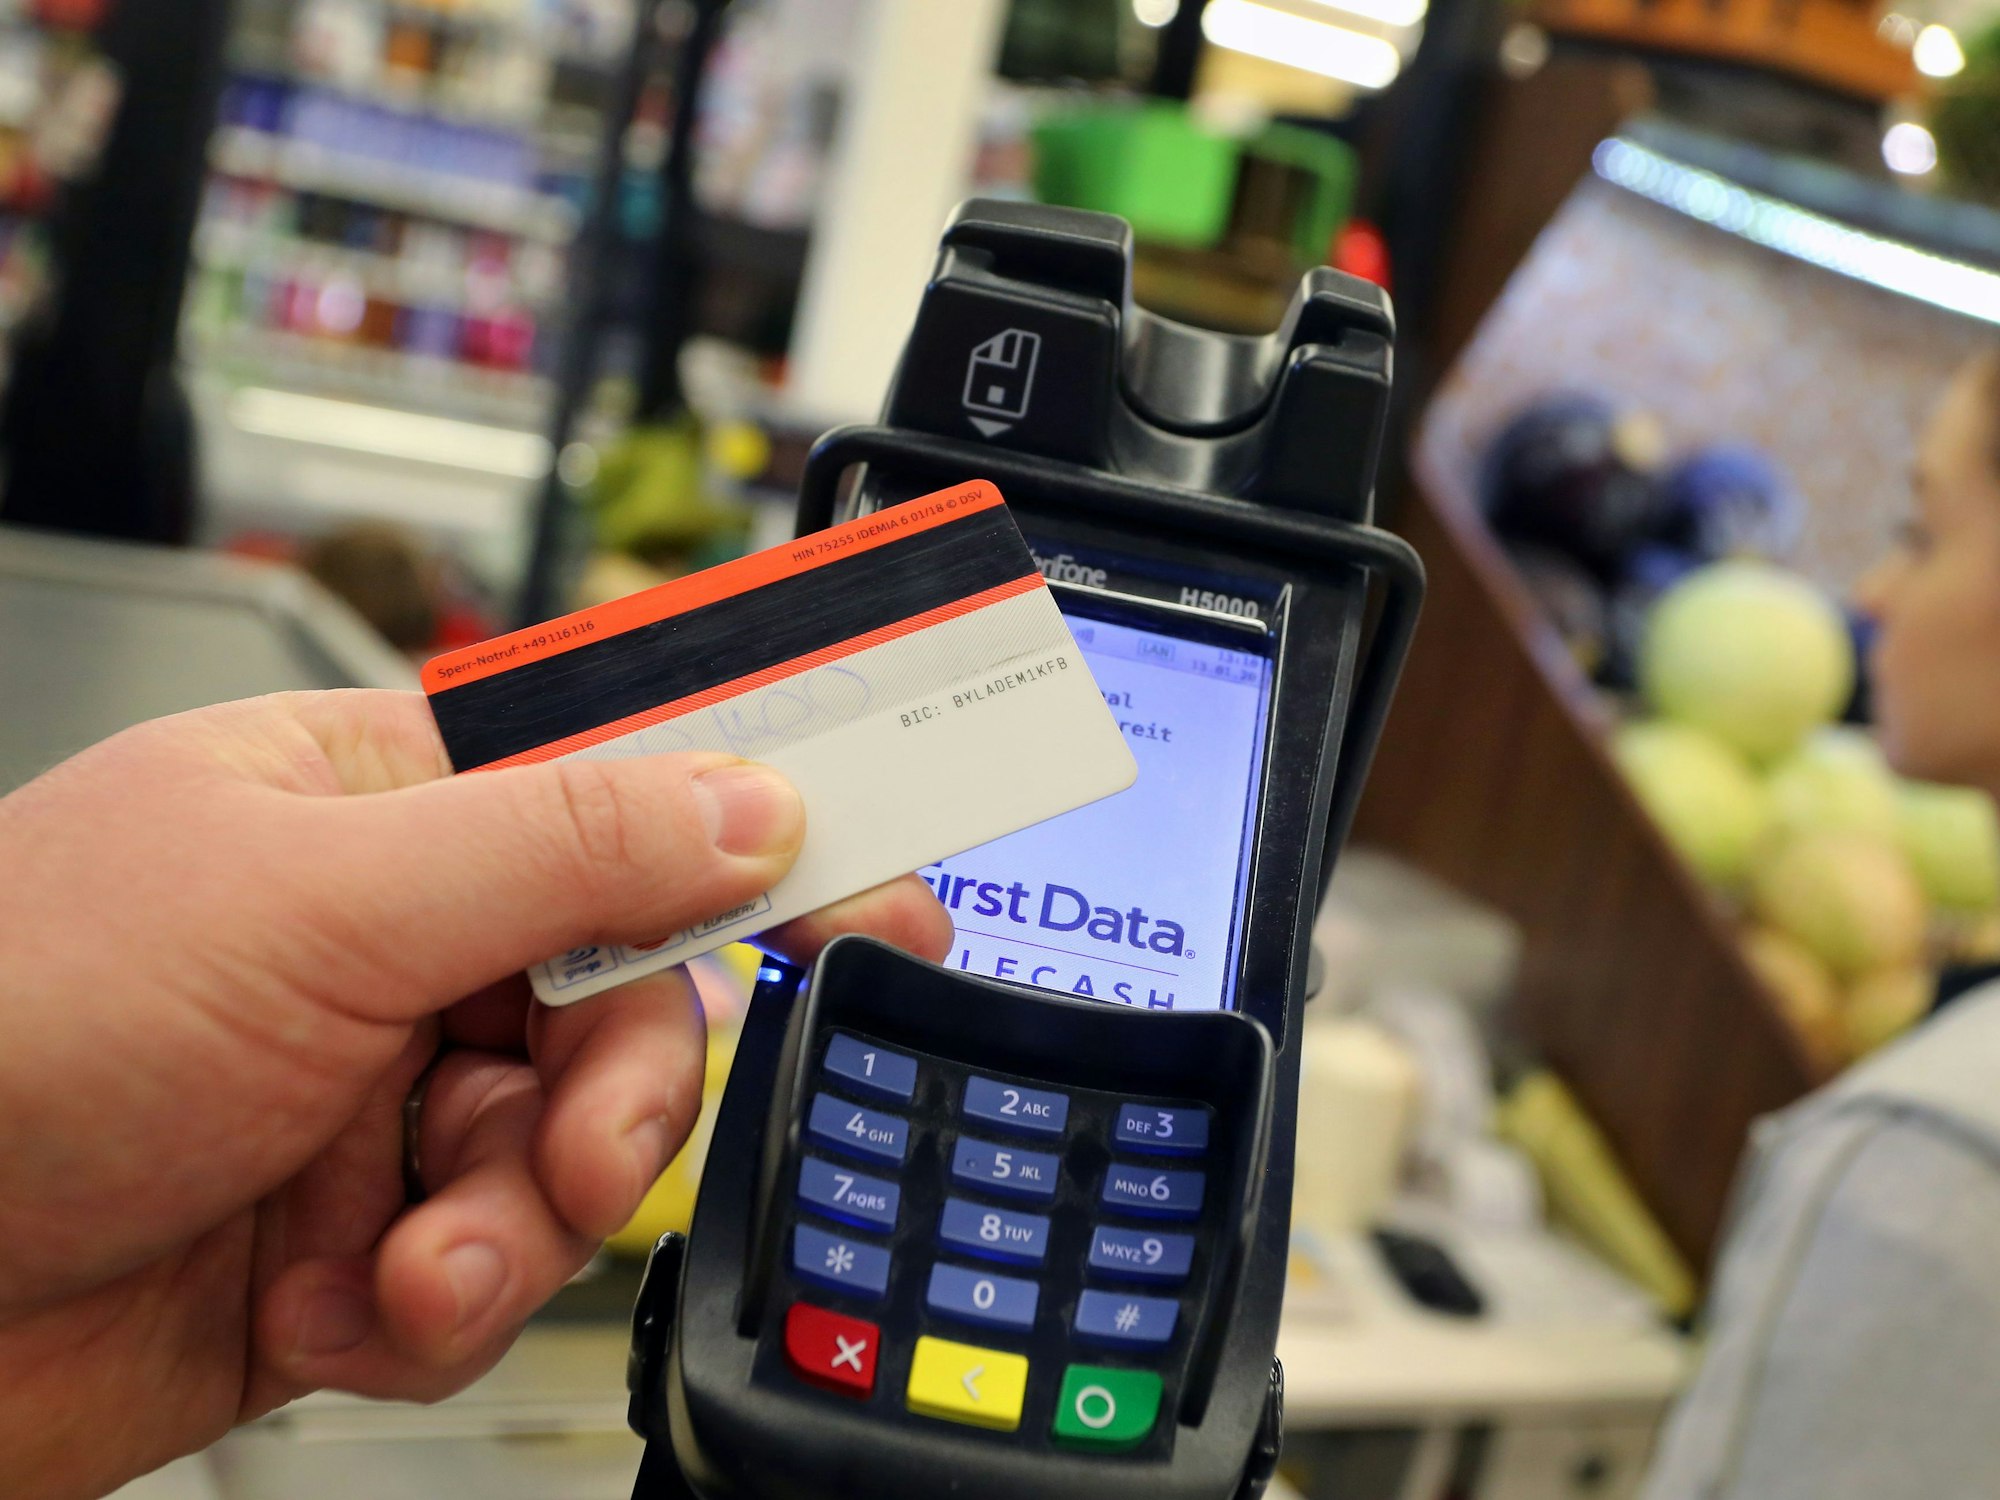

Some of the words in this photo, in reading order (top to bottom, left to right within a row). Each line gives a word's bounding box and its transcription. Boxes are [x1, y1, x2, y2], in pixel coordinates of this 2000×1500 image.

[793, 547, 815, 562] HIN
[818, 534, 855, 553] 75255
[856, 518, 899, 540] IDEMIA
[900, 514, 909, 526] 6
[911, 502, 944, 522] 01/18
[959, 488, 983, 506] DSV
[1029, 548, 1108, 589] riFone
[1180, 586, 1259, 620] H5000
[437, 645, 520, 679] Sperr-Notruf:
[523, 635, 547, 651] +49
[900, 704, 942, 728] BIC:
[952, 655, 1069, 709] BYLADEM1KFB
[1100, 690, 1133, 709] al
[863, 1052, 876, 1076] 1
[999, 1090, 1020, 1115] 2
[1022, 1102, 1050, 1118] ABC
[845, 1112, 866, 1137] 4
[868, 1129, 894, 1145] GHI
[1126, 1118, 1151, 1134] DEF
[1154, 1113, 1174, 1138] 3
[993, 1153, 1011, 1178] 5
[1019, 1165, 1041, 1180] JKL
[833, 1175, 853, 1201] 7
[847, 1193, 885, 1211] PQRS
[1115, 1180, 1148, 1197] MNO
[1150, 1175, 1170, 1200] 6
[979, 1214, 1000, 1240] 8
[1004, 1226, 1032, 1242] TUV
[1143, 1239, 1163, 1264] 9
[973, 1280, 995, 1309] 0
